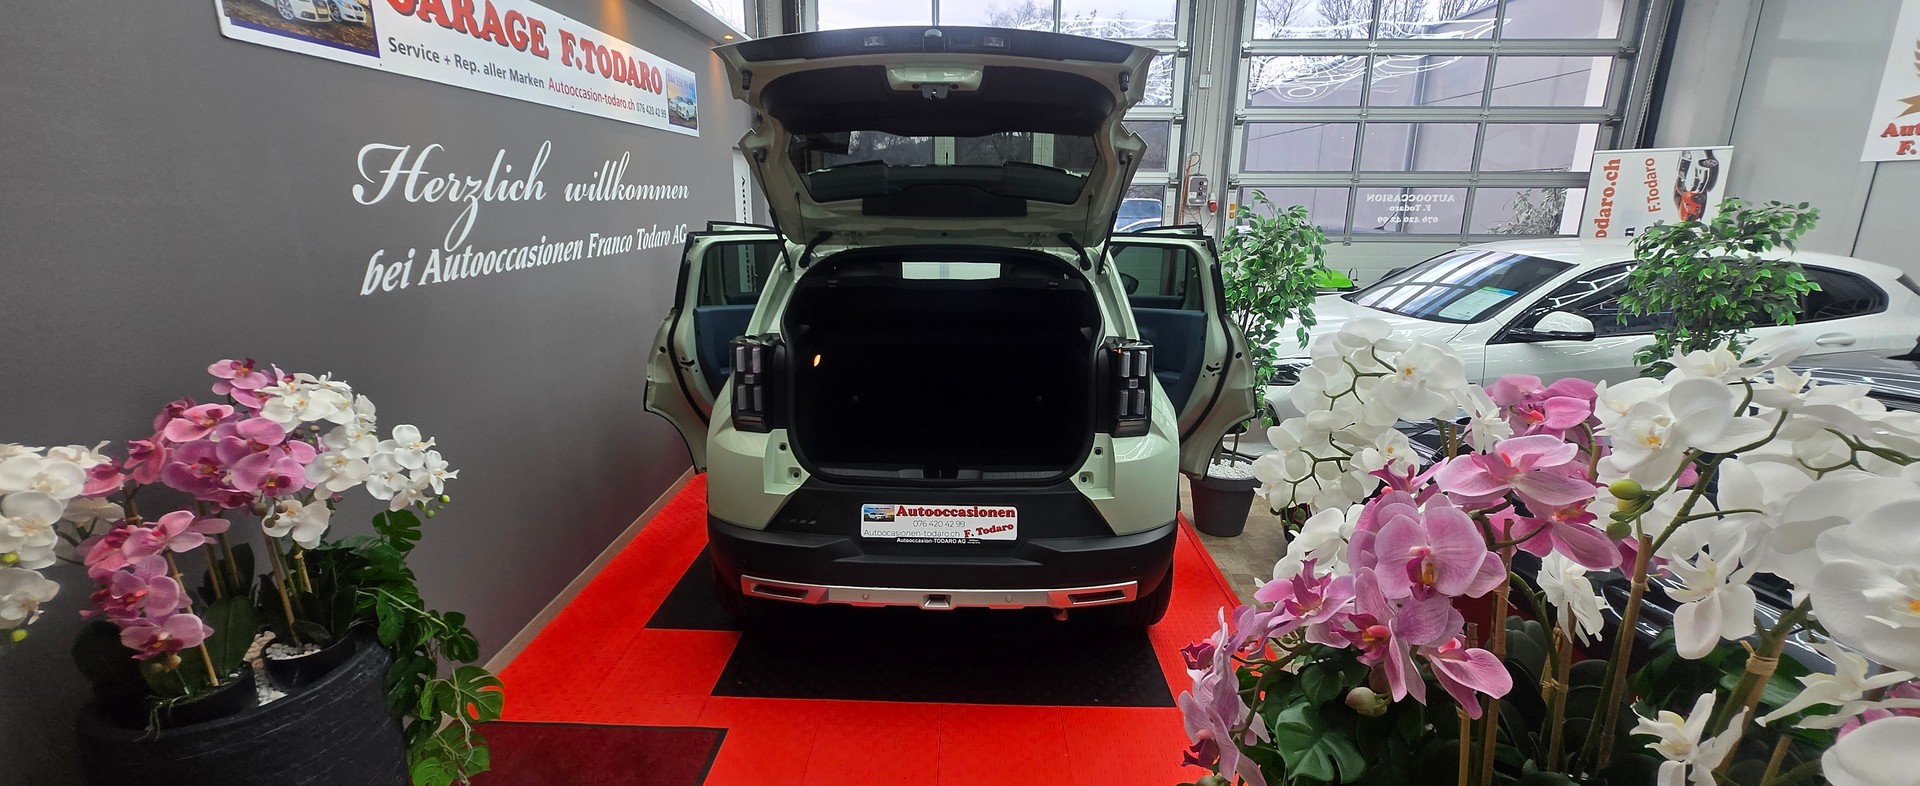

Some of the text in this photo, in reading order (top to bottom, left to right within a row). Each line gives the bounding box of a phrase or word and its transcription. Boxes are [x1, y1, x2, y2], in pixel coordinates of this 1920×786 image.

[388, 36, 440, 63] Service
[454, 53, 481, 75] Rep.
[483, 62, 507, 79] aller
[509, 68, 545, 89] Marken
[548, 77, 636, 112] Autooccasion-todaro.ch
[558, 28, 663, 95] F.TODARO
[352, 140, 552, 252] Herzlich
[563, 150, 690, 202] willkommen
[360, 223, 688, 296] bei Autooccasionen Franco Todaro AG
[896, 505, 1016, 518] Autooccasionen
[912, 520, 966, 528] 076 420 42 99
[963, 522, 1014, 538] F. Todaro
